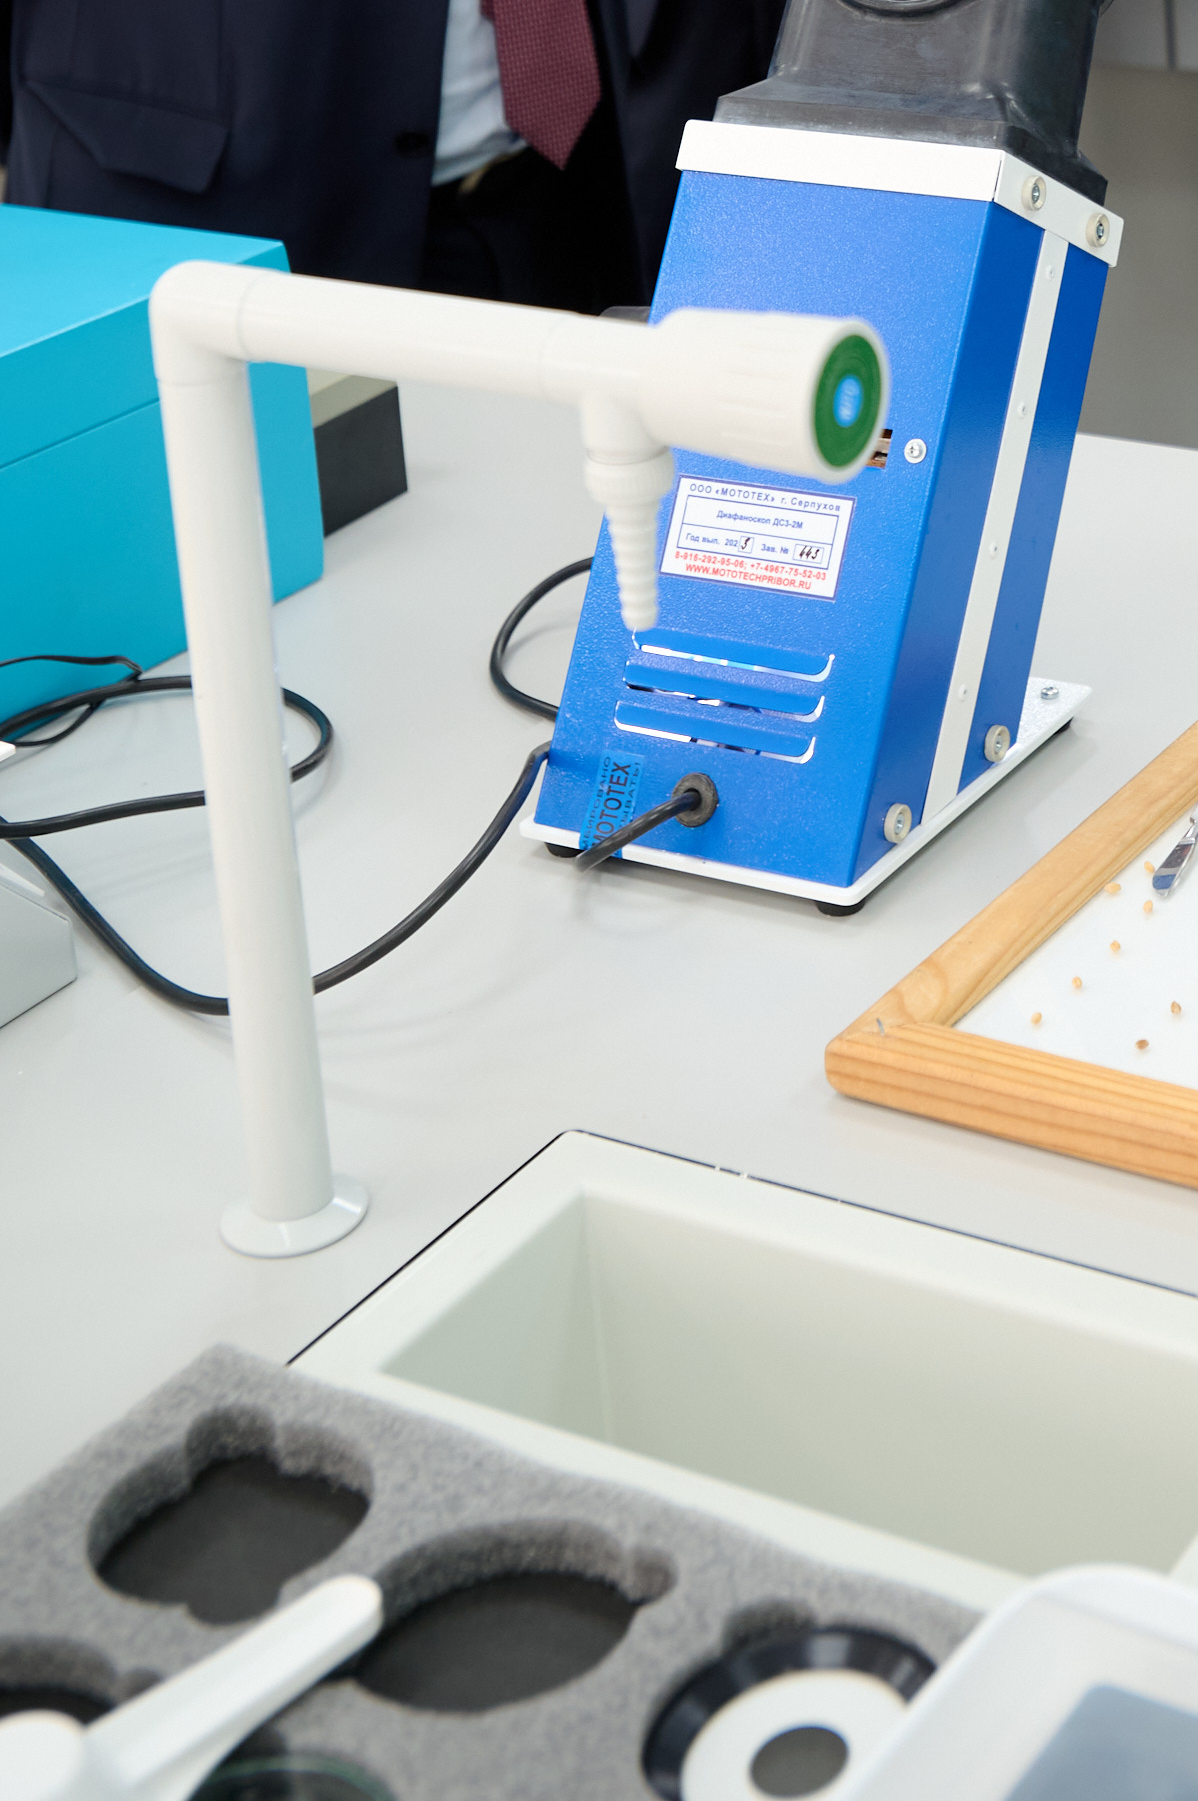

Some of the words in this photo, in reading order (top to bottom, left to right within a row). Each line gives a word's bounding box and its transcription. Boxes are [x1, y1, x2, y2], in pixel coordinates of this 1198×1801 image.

[690, 483, 712, 494] ООО
[791, 497, 841, 512] Серпухов
[716, 510, 771, 524] Диафаноскоп
[686, 532, 700, 543] Год
[702, 536, 720, 545] вып.
[761, 543, 777, 552] Зав.
[686, 563, 812, 590] WWW.MOTOTECHPRIBOR.RU
